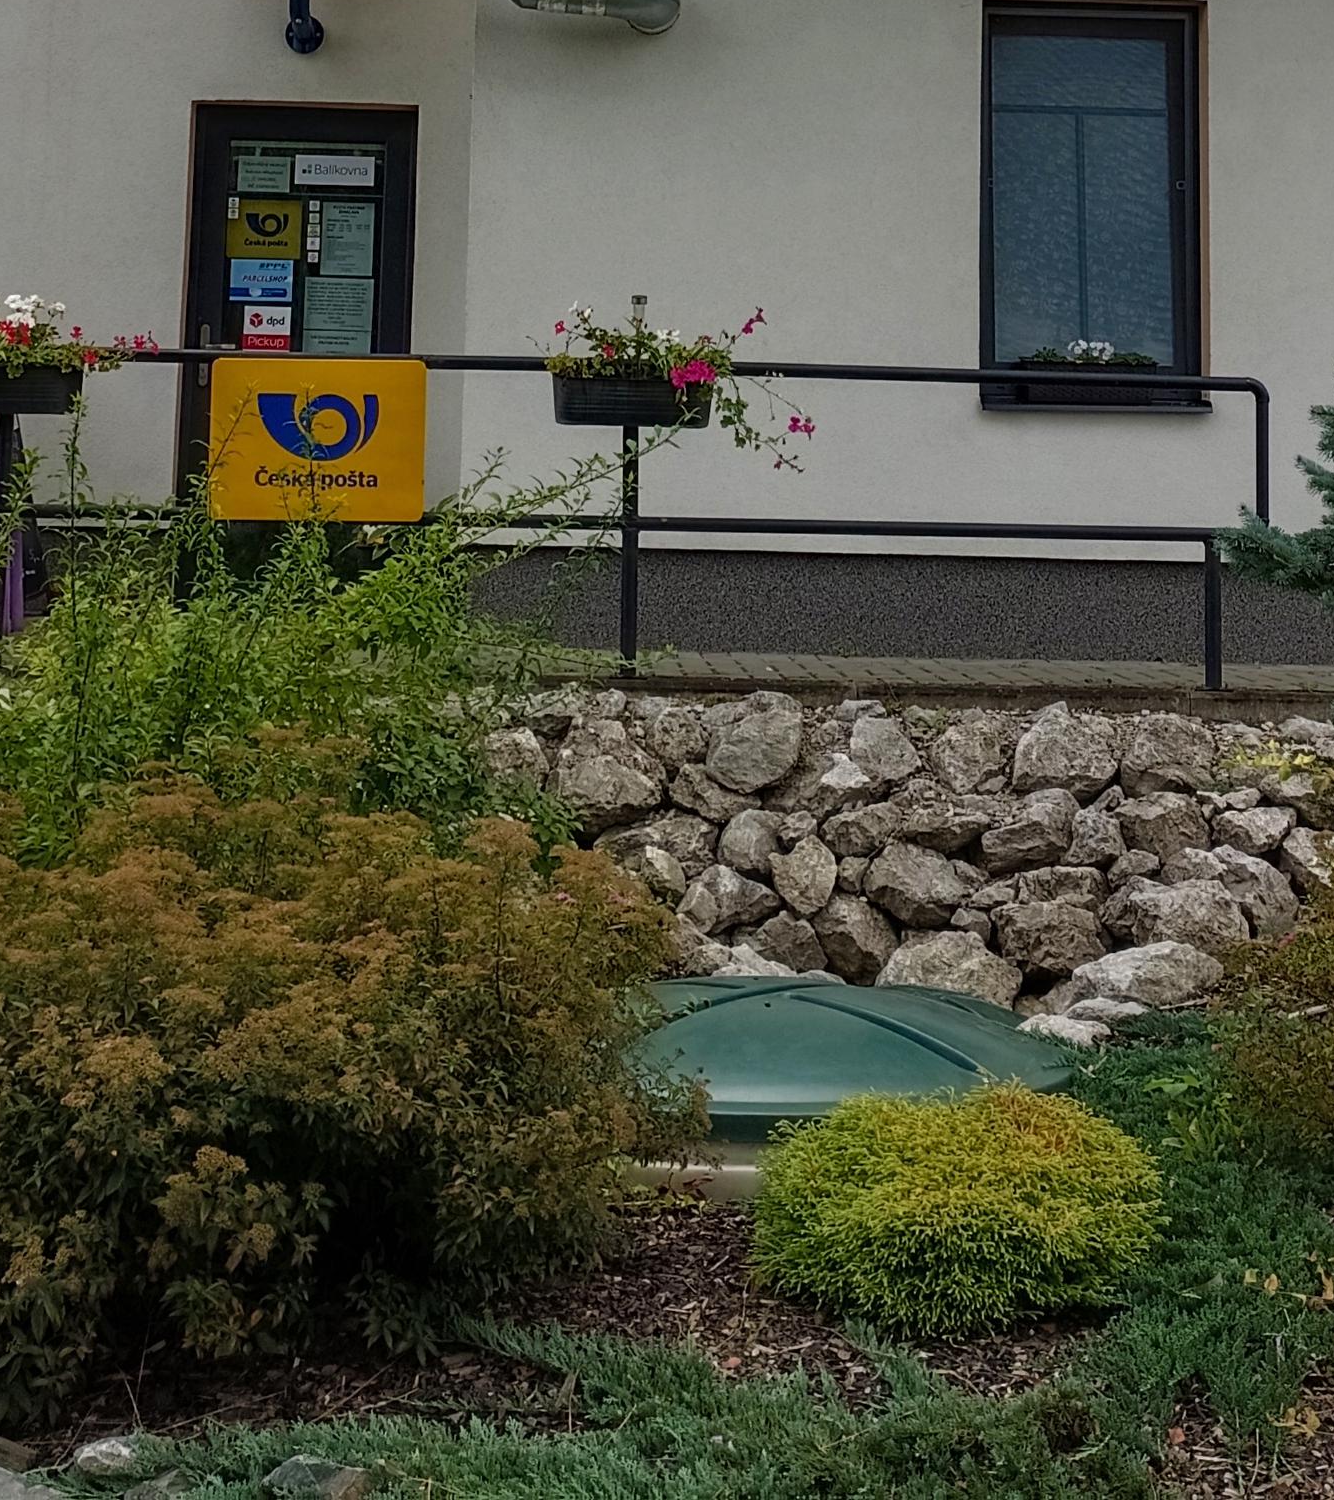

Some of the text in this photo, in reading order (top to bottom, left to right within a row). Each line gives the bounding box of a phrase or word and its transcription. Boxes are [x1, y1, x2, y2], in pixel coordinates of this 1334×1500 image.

[314, 163, 368, 176] Balíkovna
[242, 275, 288, 283] PARCELSHOP
[266, 316, 285, 327] dpd
[247, 335, 285, 348] Pickup
[320, 470, 378, 491] pošta
